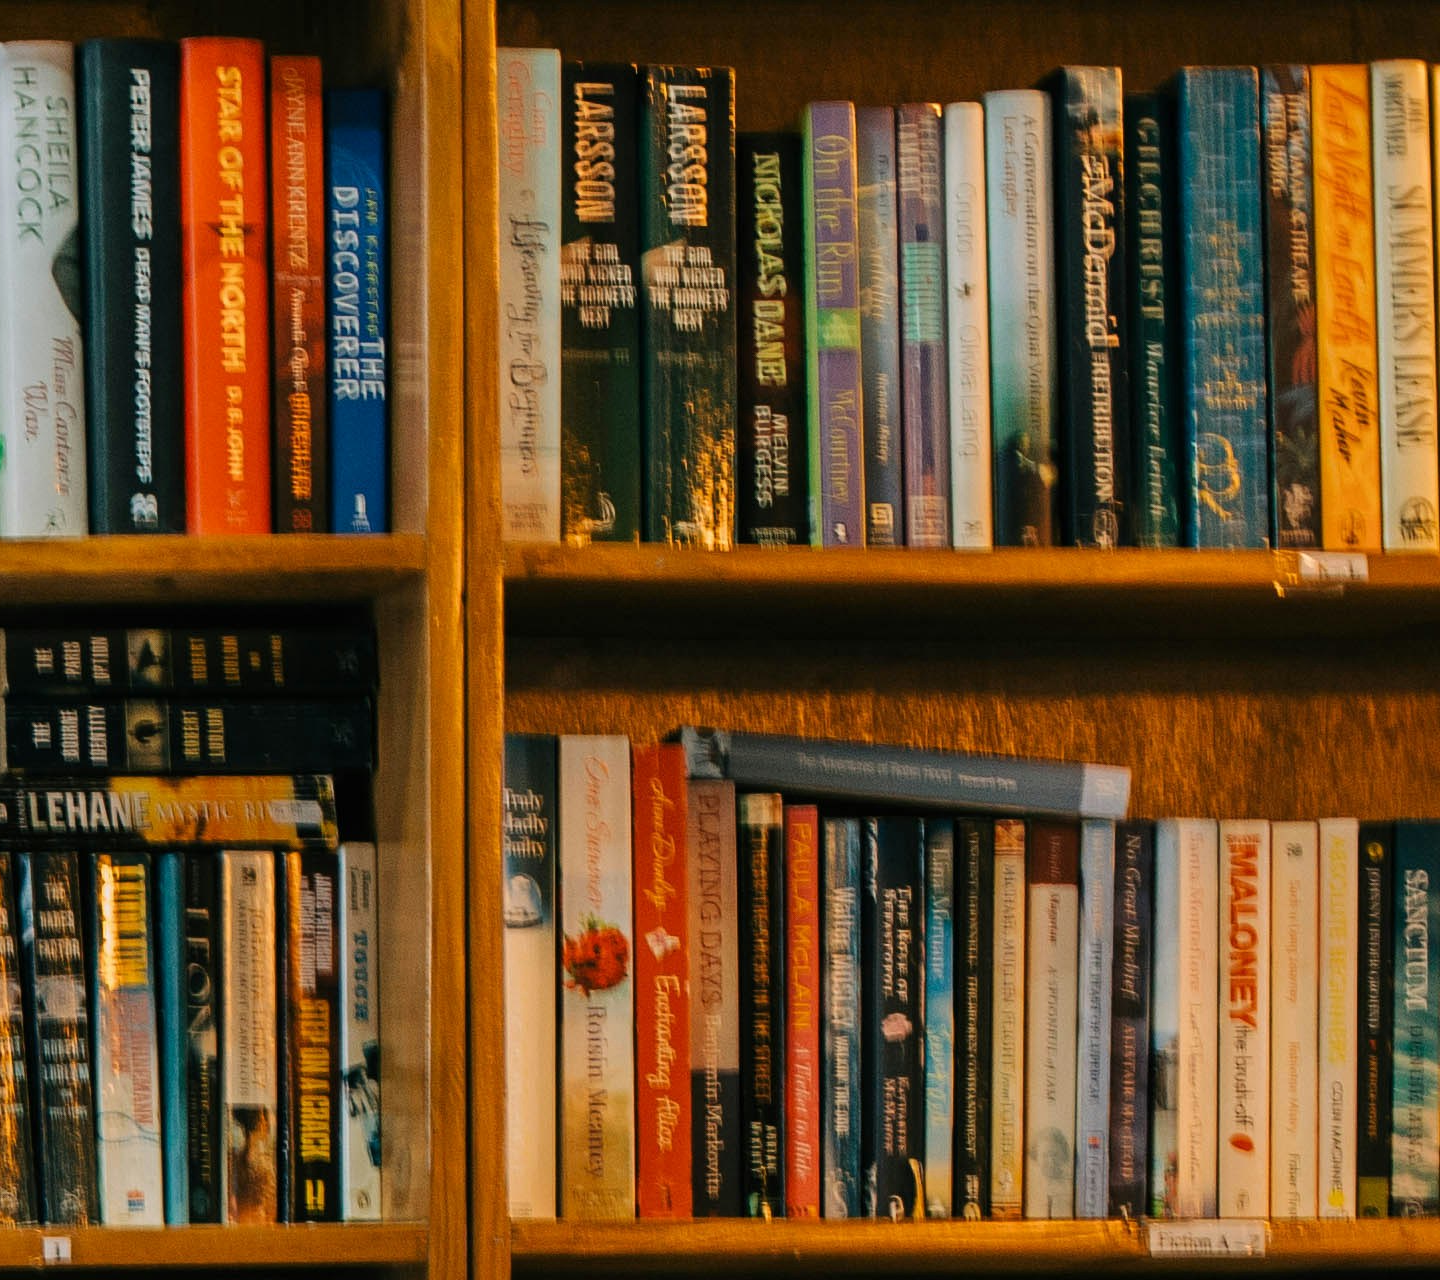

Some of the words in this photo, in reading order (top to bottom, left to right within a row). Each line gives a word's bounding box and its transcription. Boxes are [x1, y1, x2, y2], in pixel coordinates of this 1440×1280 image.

[217, 67, 243, 138] STAR
[219, 147, 244, 187] OF
[574, 83, 616, 222] LARSSON
[219, 195, 245, 255] THE
[219, 262, 247, 371] NORTH
[333, 186, 361, 399] DISCOVERER
[357, 336, 387, 399] THE
[28, 791, 152, 832] LEHANE
[1227, 844, 1256, 1026] MALONEY
